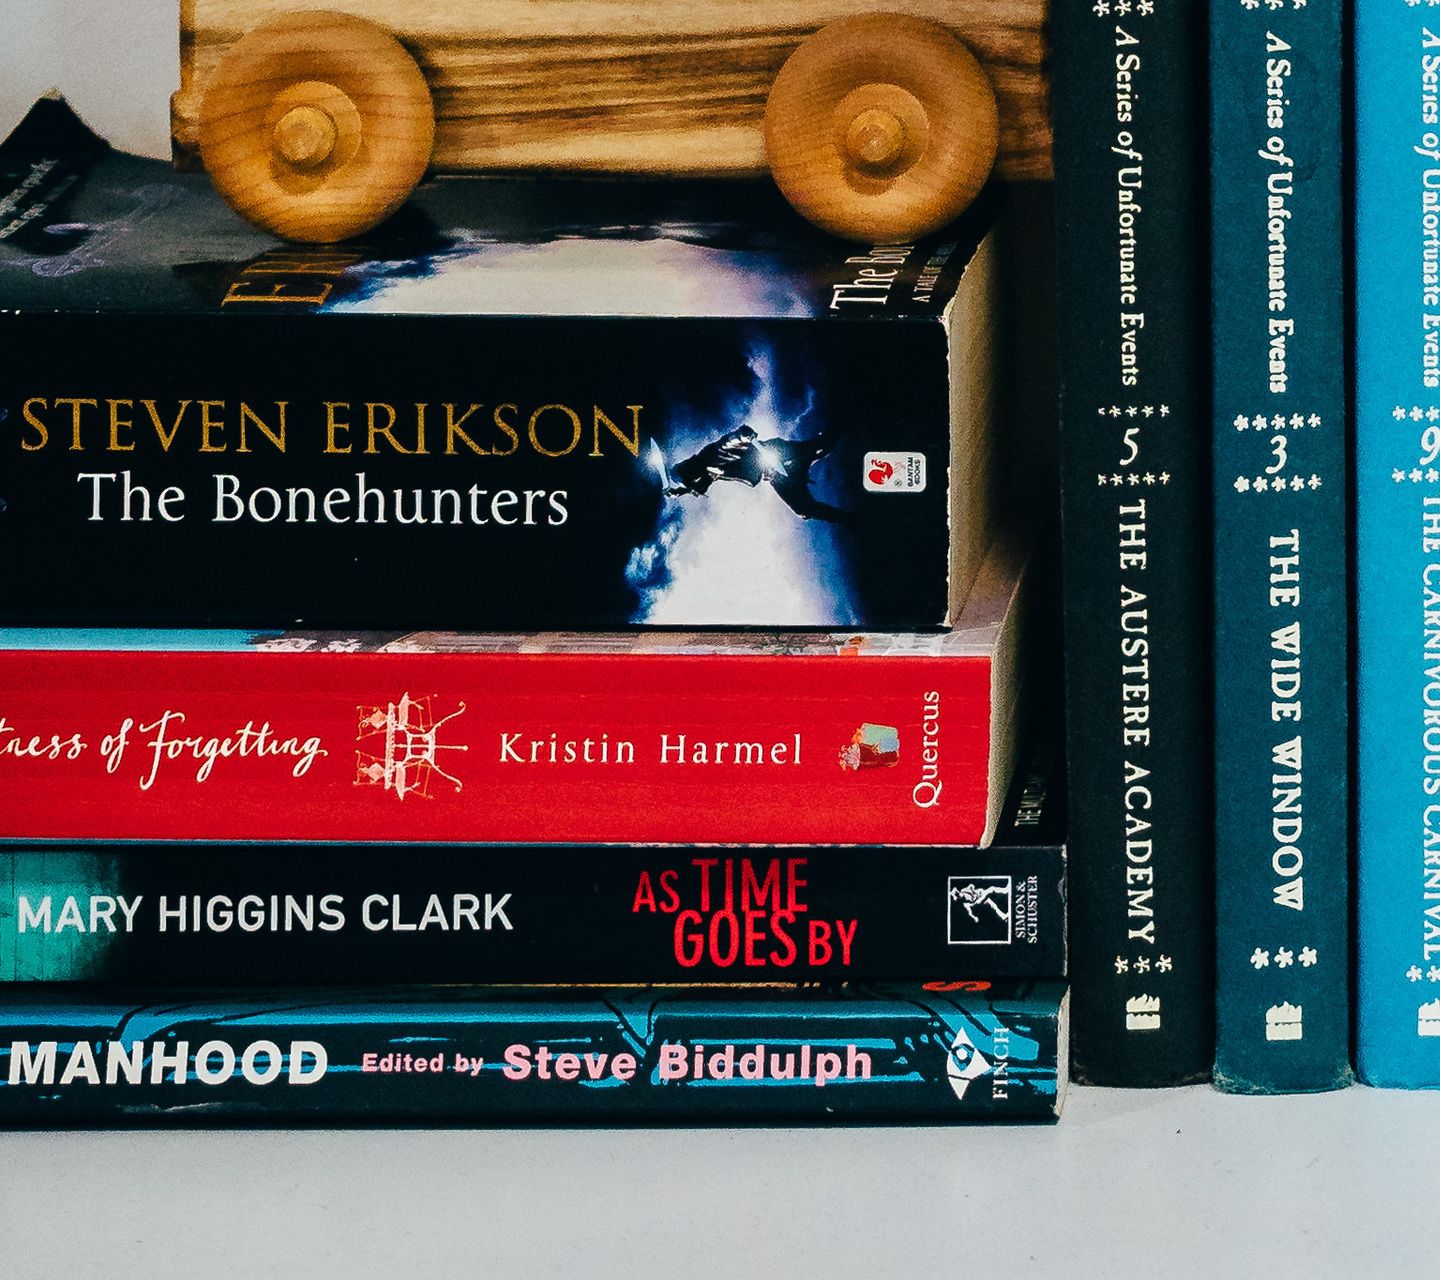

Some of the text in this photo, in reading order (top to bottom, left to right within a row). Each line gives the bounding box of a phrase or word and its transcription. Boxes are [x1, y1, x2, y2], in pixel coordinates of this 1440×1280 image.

[1111, 26, 1144, 387] A Series of Unfortunate Events
[1258, 31, 1294, 395] A Series of Unfortunate Events
[830, 269, 898, 310] The
[21, 397, 643, 458] STEVEN ERIKSON
[1119, 427, 1139, 466] 5
[1265, 435, 1288, 474] 3
[77, 471, 569, 526] The Bonehunters
[100, 717, 133, 774] of
[499, 732, 802, 764] Kristin Harmel
[912, 690, 941, 808] Quercus
[1119, 499, 1155, 944] THE AUSTERE ACADEMY
[1269, 529, 1303, 911] THE WIDE WINDOW
[17, 893, 513, 933] MARY HIGGINS CLARK
[632, 857, 808, 913] AS TIME
[1015, 881, 1027, 939] SIMON &
[1027, 875, 1037, 944] SCHUSTER
[672, 908, 858, 967] GOES BY
[8, 1041, 873, 1087] MANHOOD Edited by Steve Biddulph
[993, 1027, 1009, 1100] FINCH
